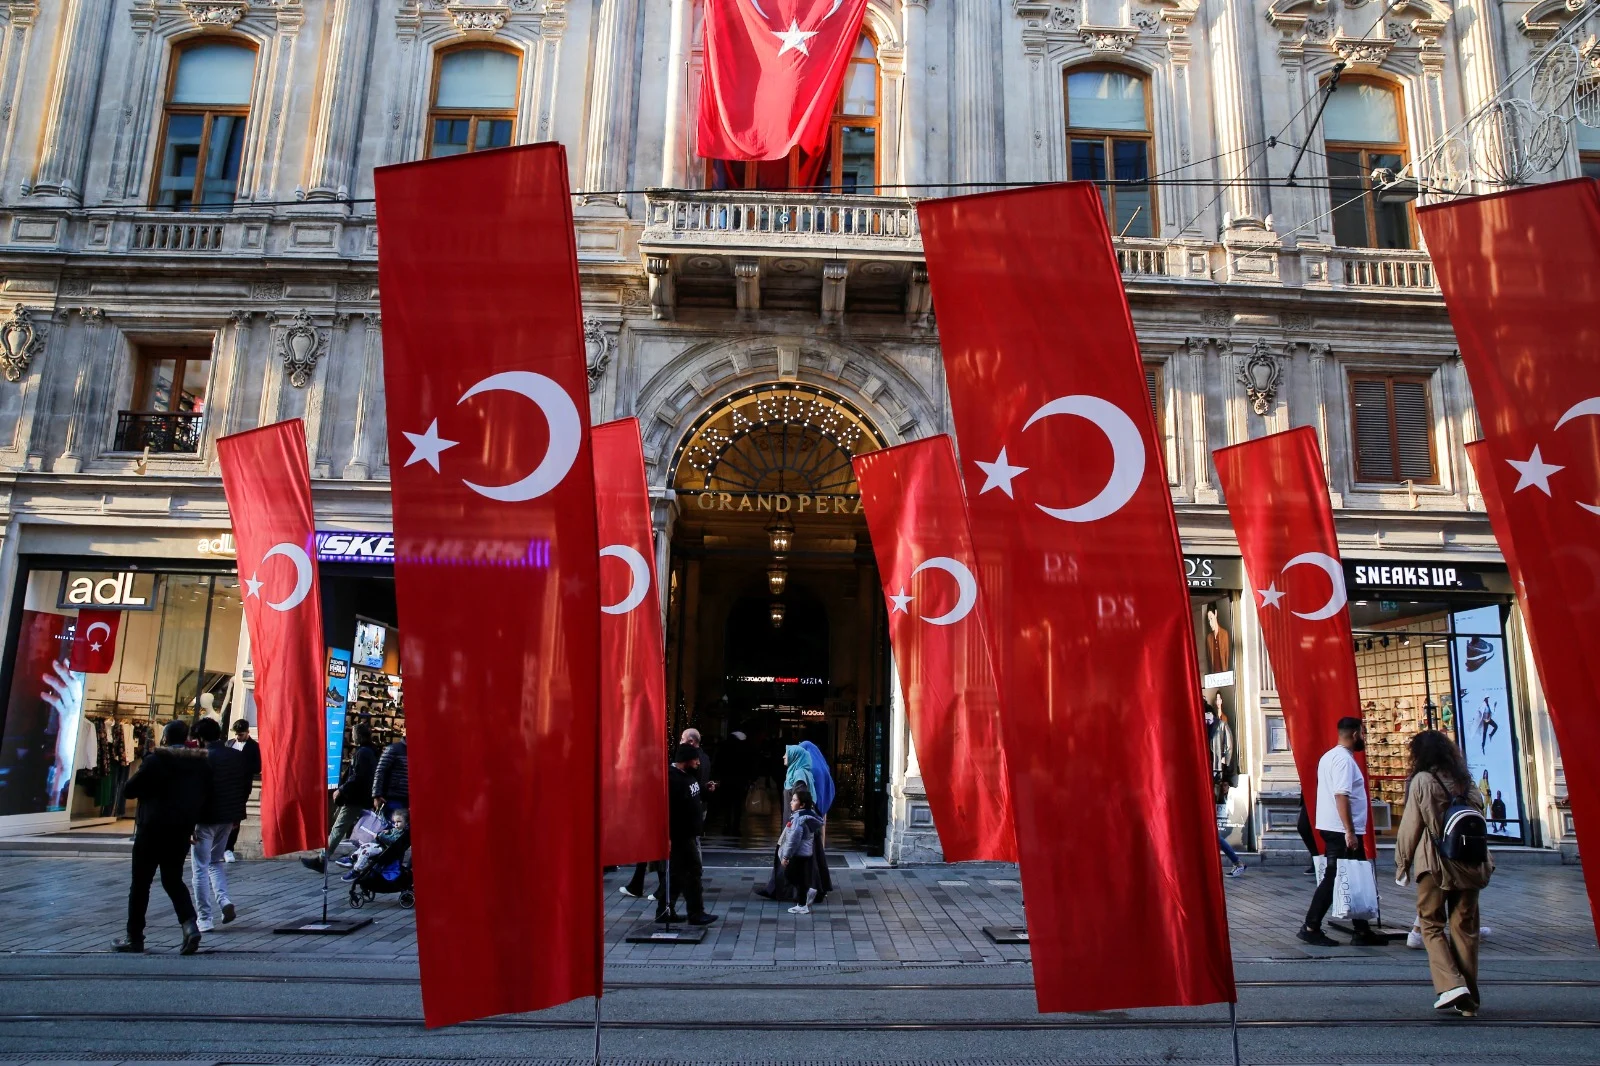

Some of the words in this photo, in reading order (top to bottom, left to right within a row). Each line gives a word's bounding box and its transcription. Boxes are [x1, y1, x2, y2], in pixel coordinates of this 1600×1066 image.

[697, 492, 791, 512] GRAND
[197, 533, 236, 553] adL
[1187, 579, 1213, 587] amat
[1355, 565, 1430, 585] SNEAKS
[68, 572, 145, 605] adL
